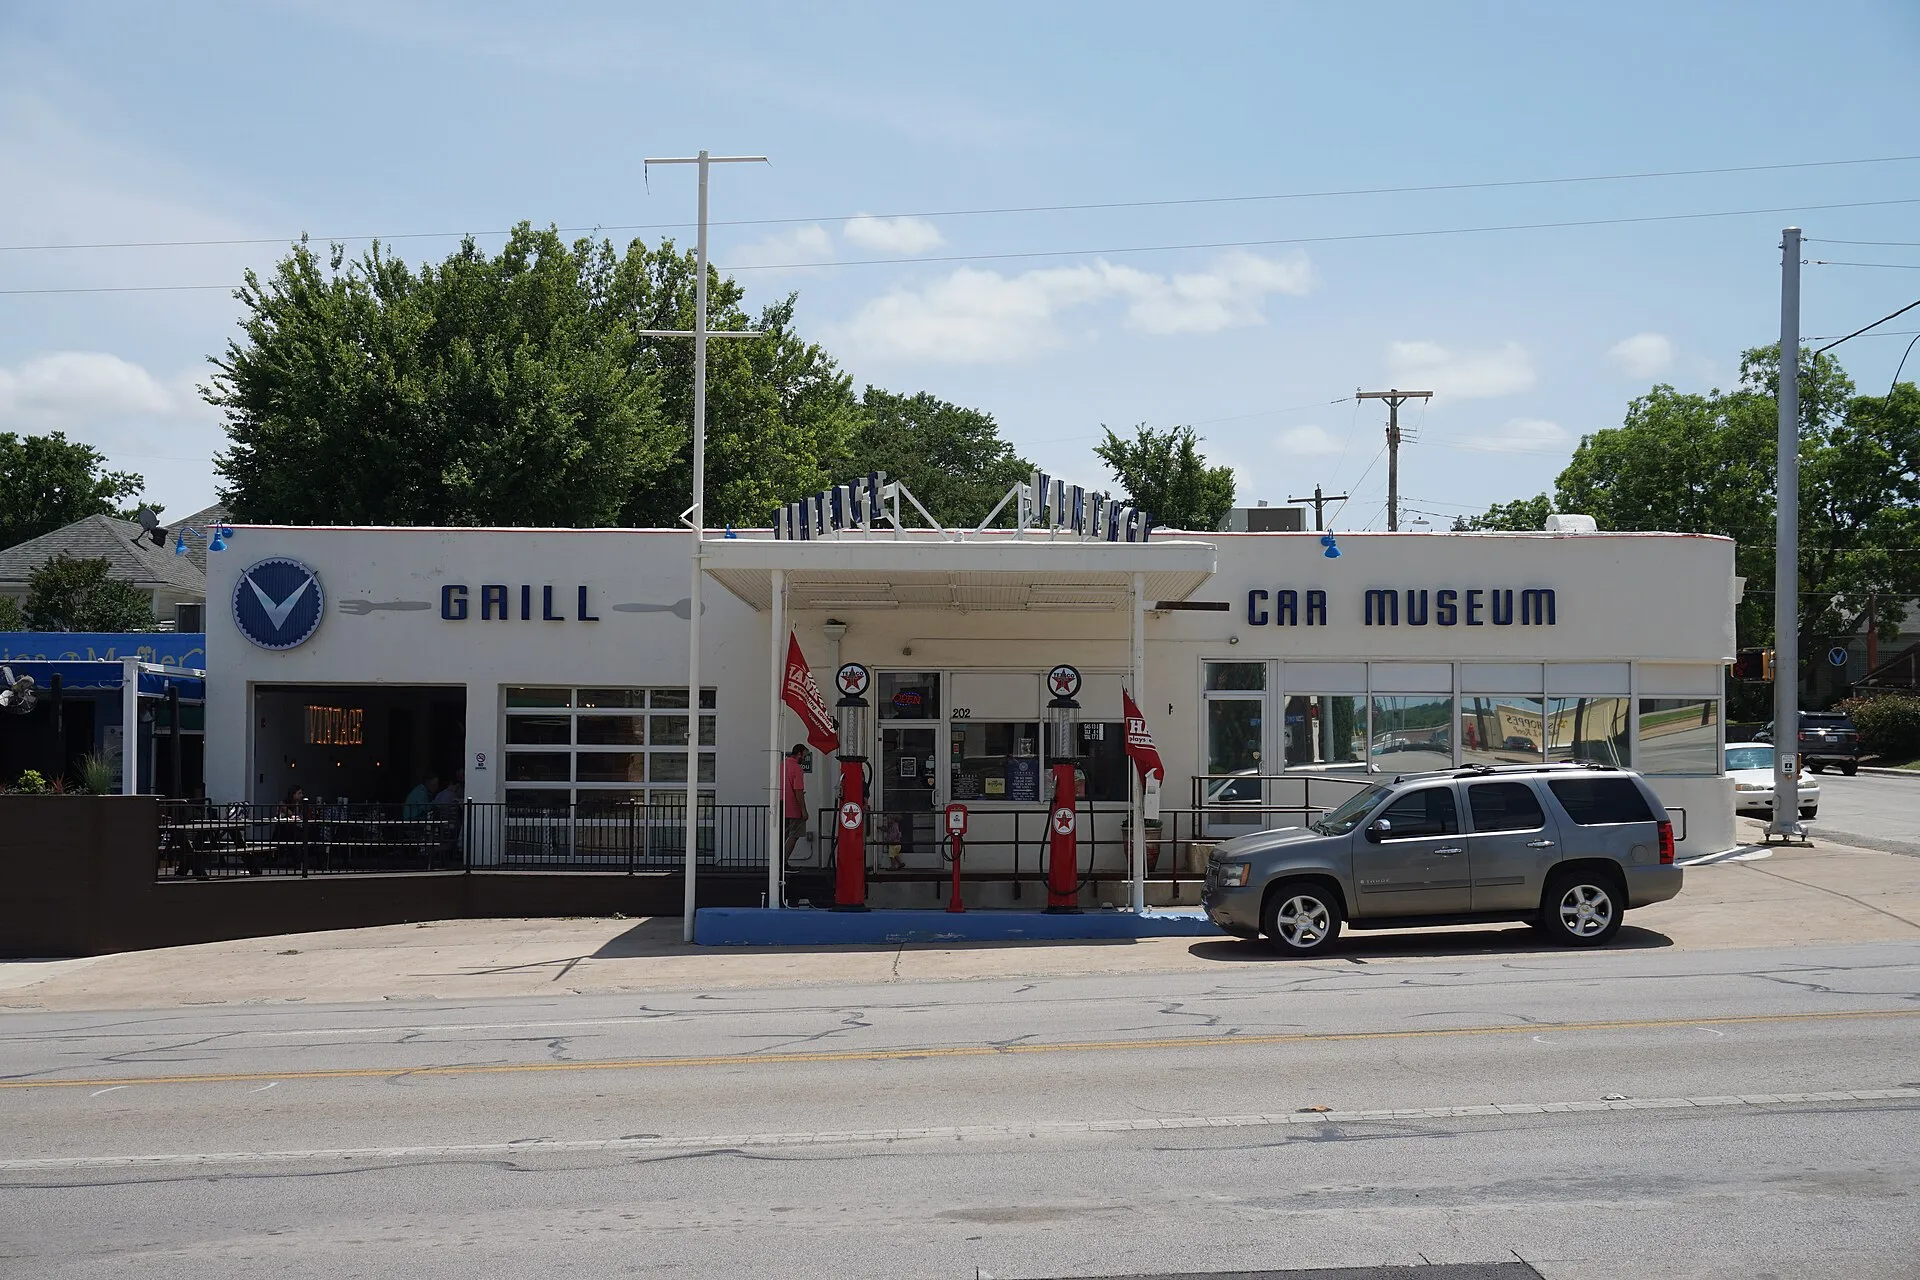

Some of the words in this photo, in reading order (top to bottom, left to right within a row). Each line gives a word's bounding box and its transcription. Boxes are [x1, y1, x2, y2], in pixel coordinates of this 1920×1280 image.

[440, 584, 600, 622] GRILL
[1247, 588, 1328, 626] CAR
[1363, 587, 1557, 626] MUSEUM
[892, 692, 922, 705] OPEN
[952, 708, 971, 719] 202
